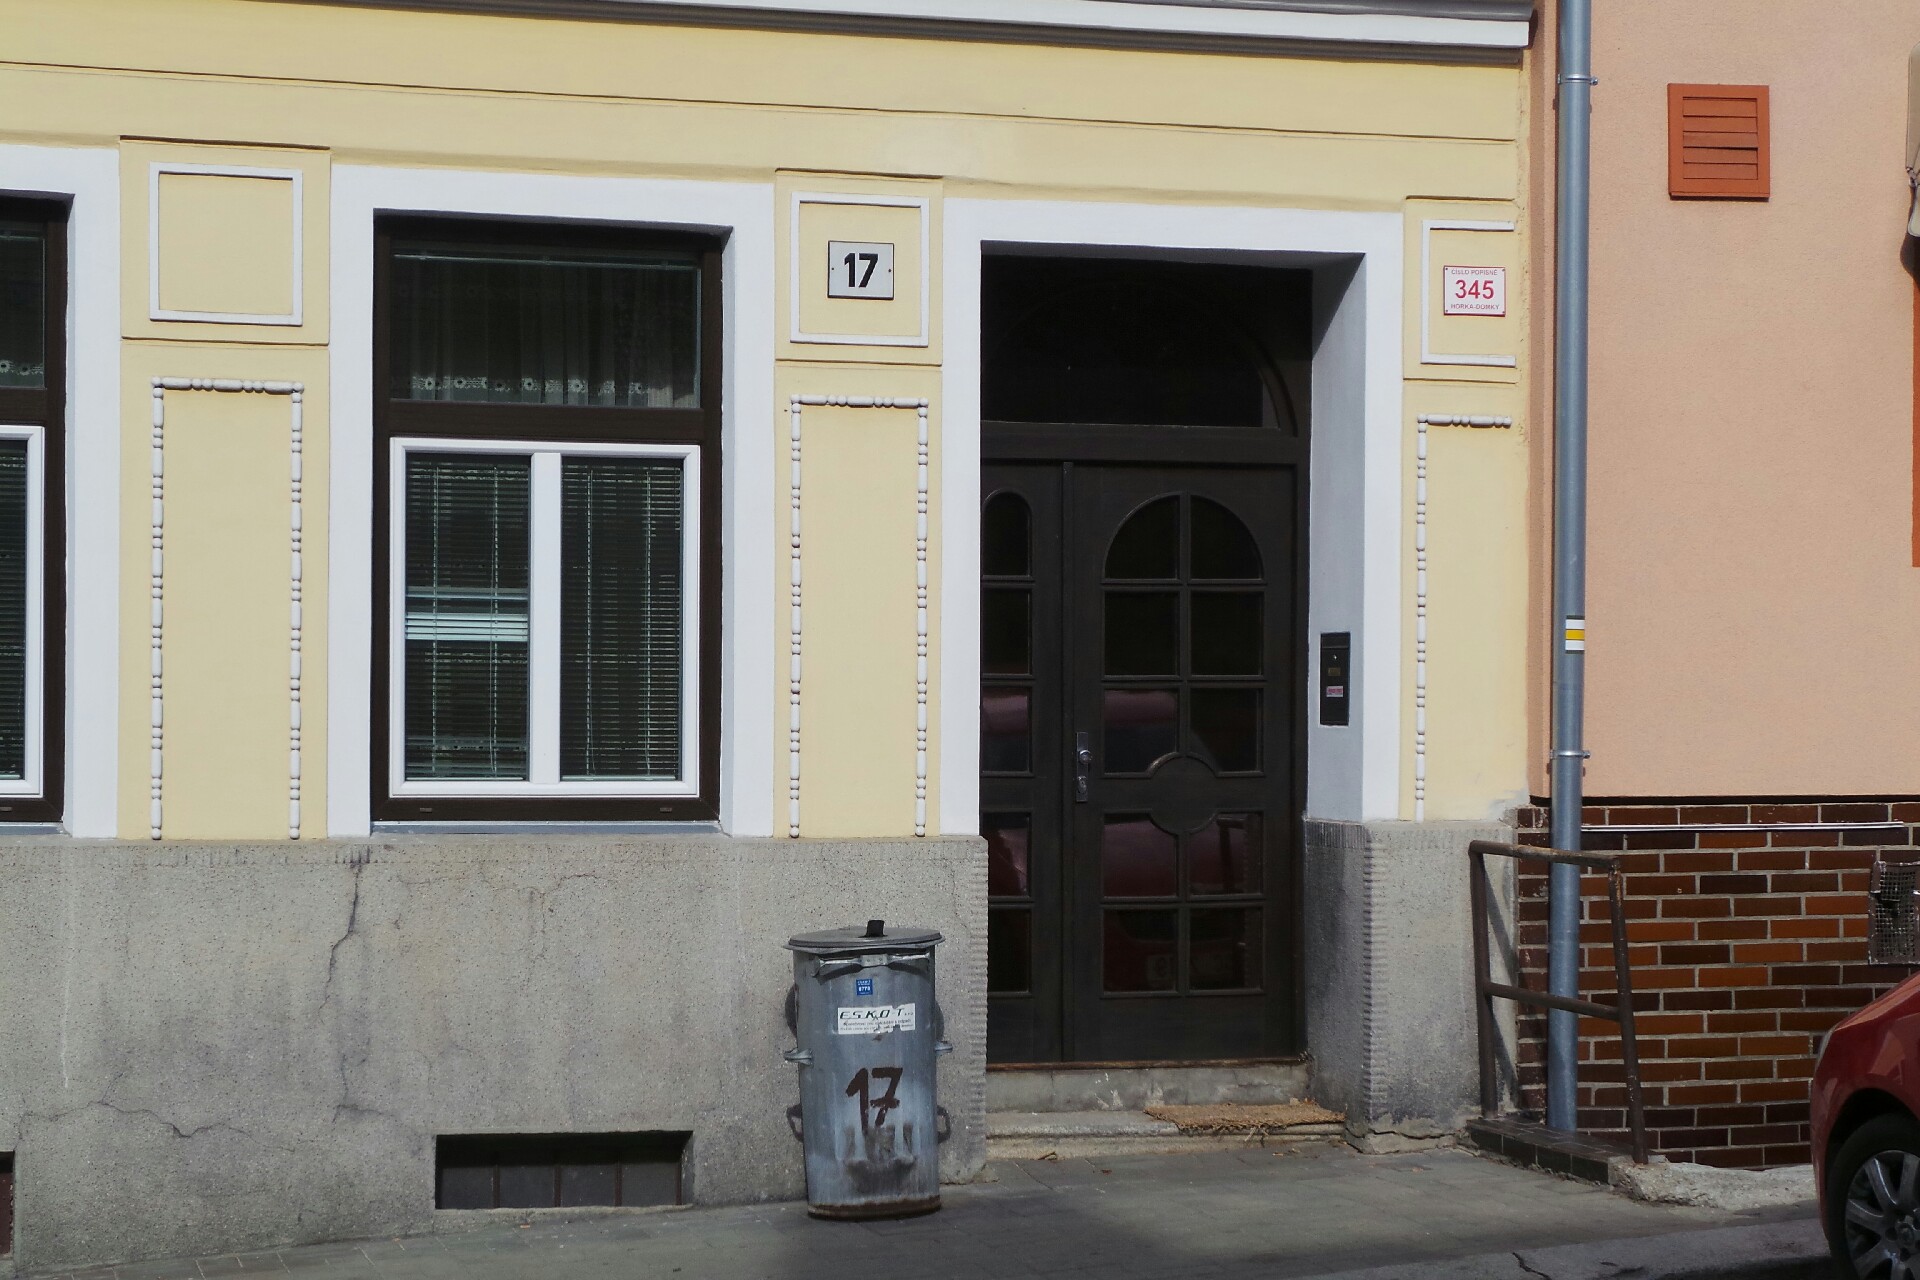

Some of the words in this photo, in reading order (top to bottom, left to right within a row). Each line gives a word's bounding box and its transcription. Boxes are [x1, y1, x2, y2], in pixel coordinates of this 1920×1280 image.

[844, 252, 879, 288] 17
[1455, 279, 1495, 300] 345
[845, 1066, 904, 1136] 17
